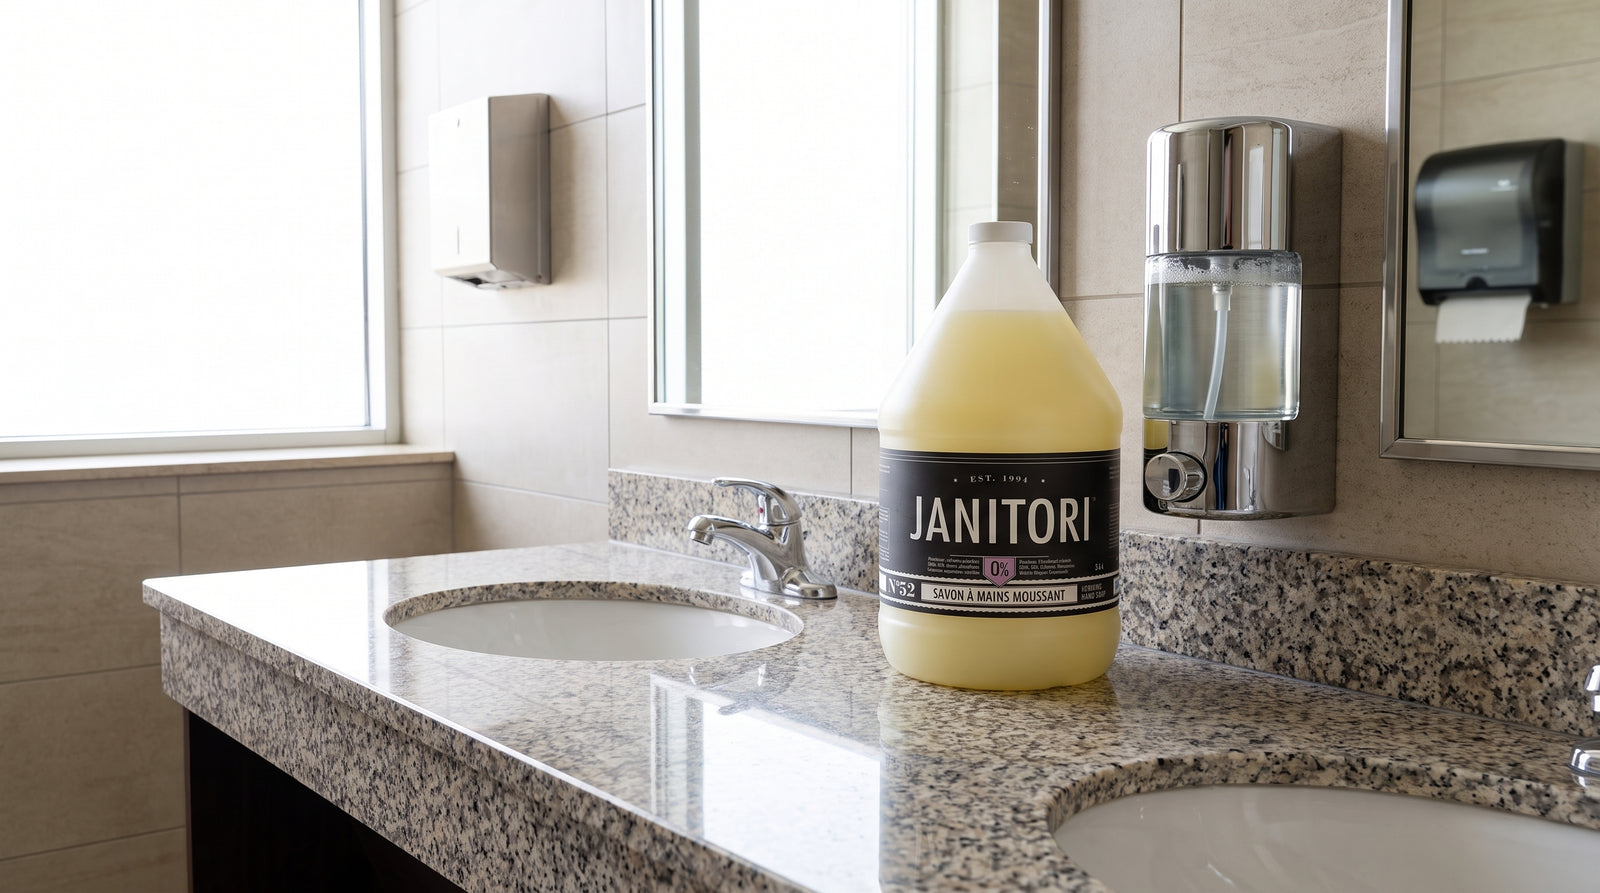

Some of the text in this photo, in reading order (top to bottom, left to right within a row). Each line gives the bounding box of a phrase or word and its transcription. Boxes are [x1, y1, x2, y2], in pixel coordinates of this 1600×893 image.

[970, 474, 1027, 483] EST. 1994
[910, 496, 1090, 544] JANITORI
[991, 561, 1008, 576] 0%
[933, 588, 1066, 602] SAVON À MAINS MOUSSANT
